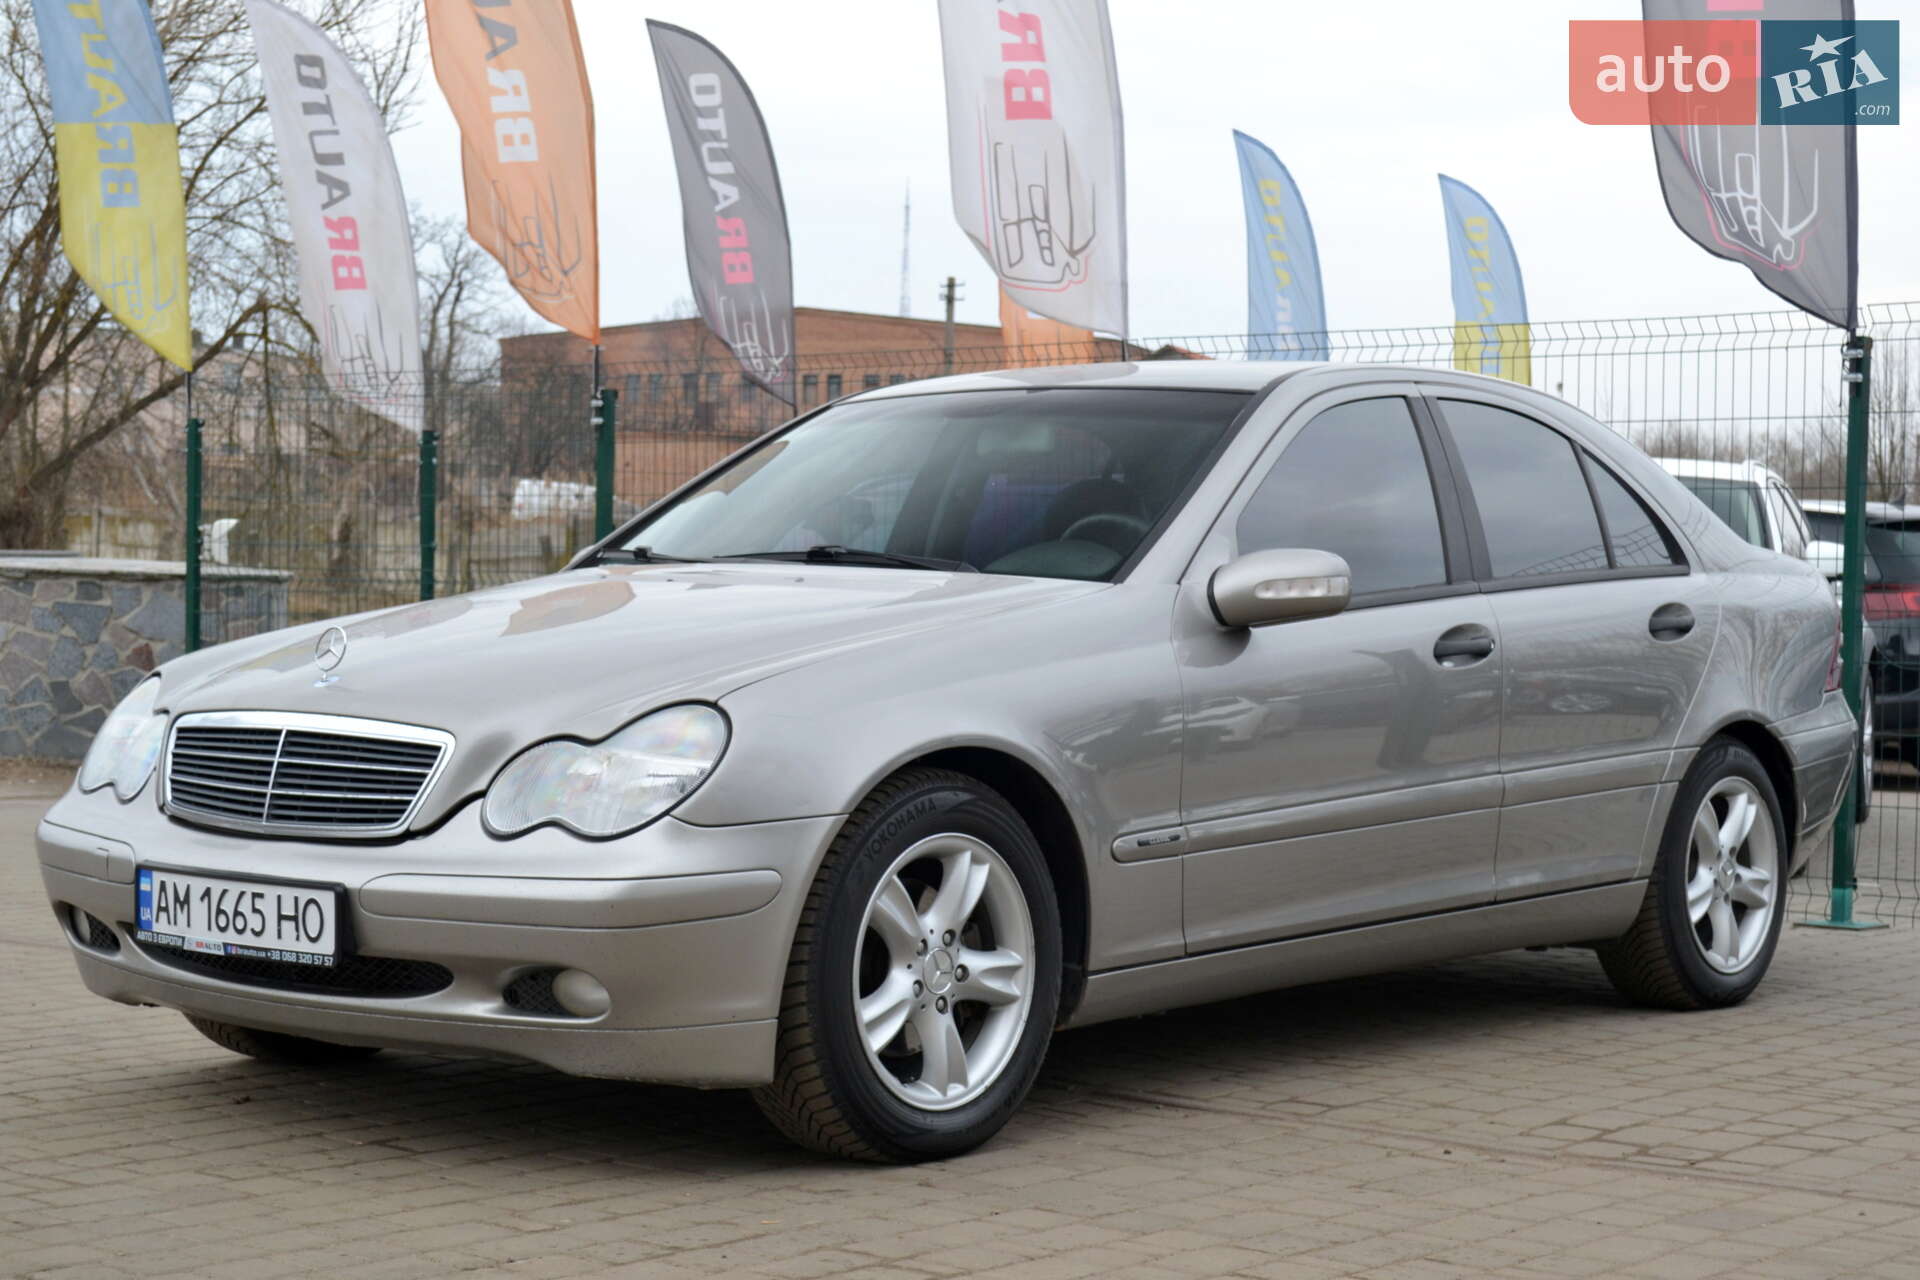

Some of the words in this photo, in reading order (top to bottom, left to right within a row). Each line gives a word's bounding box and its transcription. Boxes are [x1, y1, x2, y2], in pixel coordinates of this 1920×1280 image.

[863, 797, 937, 862] YOKOHAMA
[140, 907, 152, 921] UA
[155, 880, 191, 928] AM
[200, 886, 266, 937] 1665
[277, 894, 324, 943] HO
[298, 953, 312, 964] 320
[314, 955, 323, 965] 57
[324, 956, 333, 966] 57
